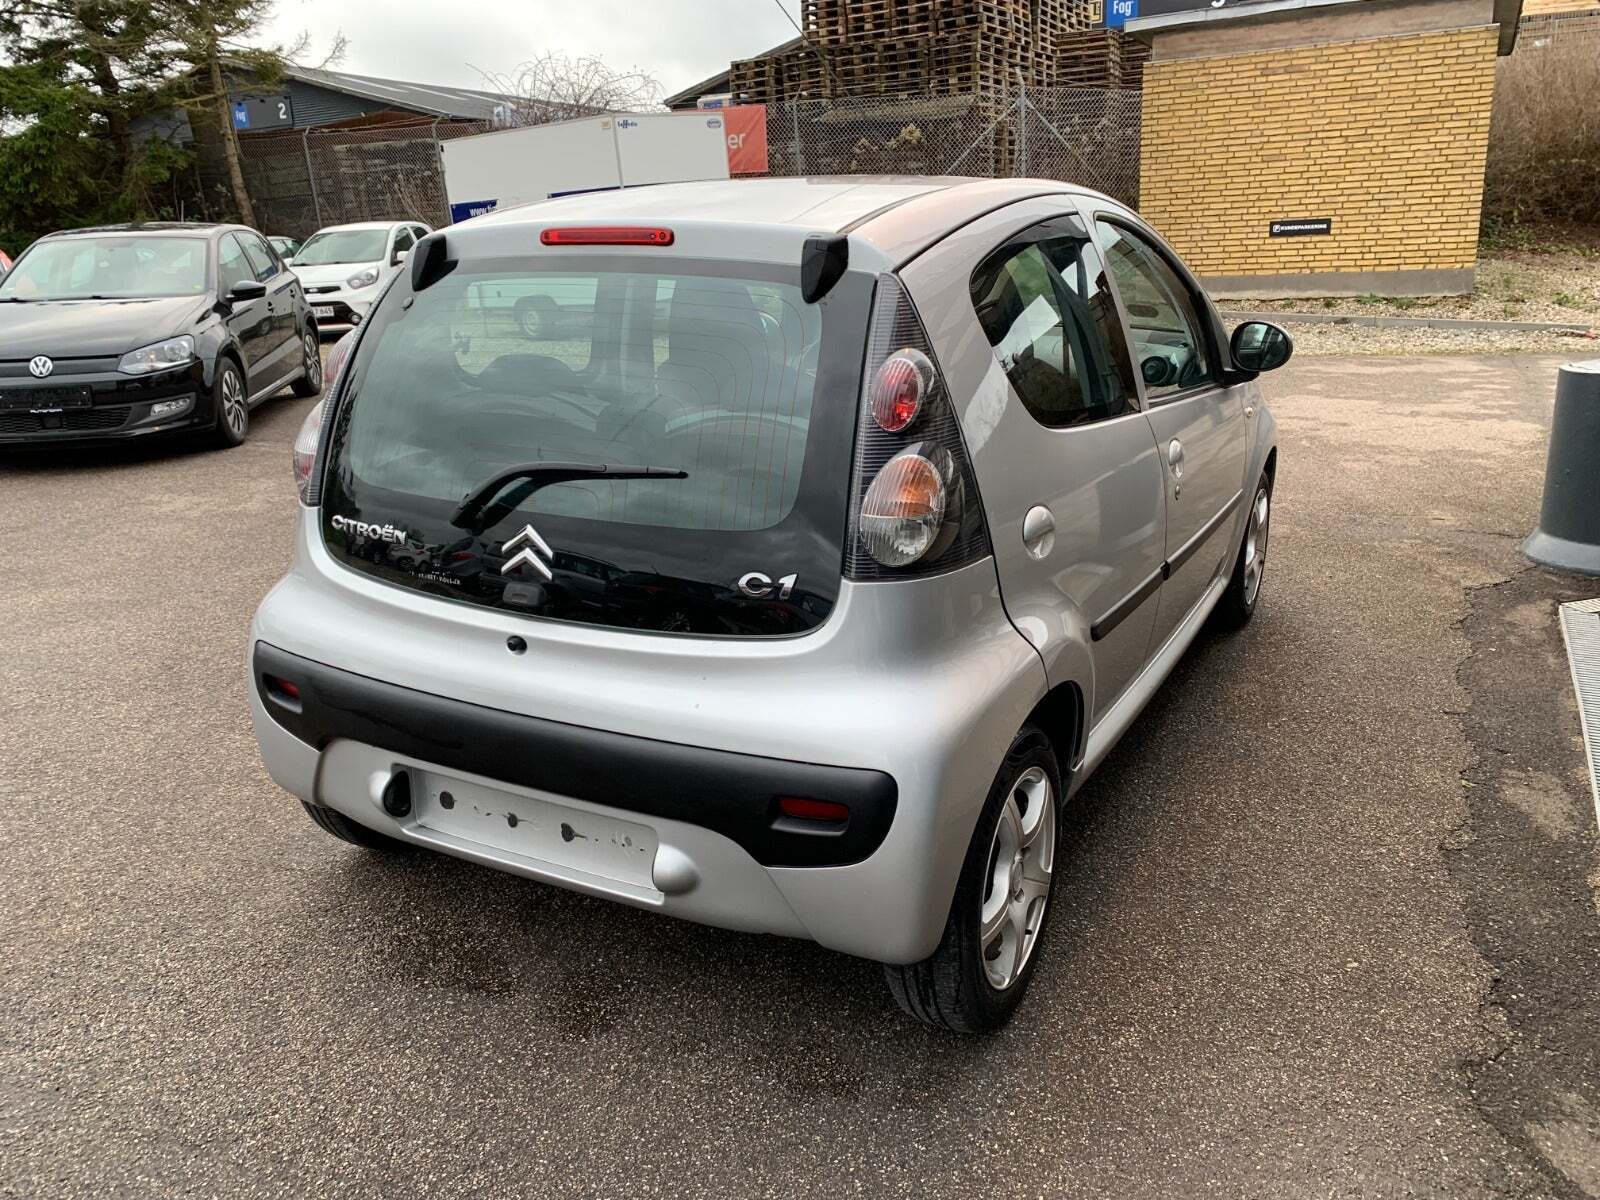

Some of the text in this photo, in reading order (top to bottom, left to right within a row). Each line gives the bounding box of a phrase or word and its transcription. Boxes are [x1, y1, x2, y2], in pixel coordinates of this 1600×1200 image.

[277, 102, 288, 119] 2
[331, 514, 408, 545] CITROËN
[738, 572, 798, 600] C1
